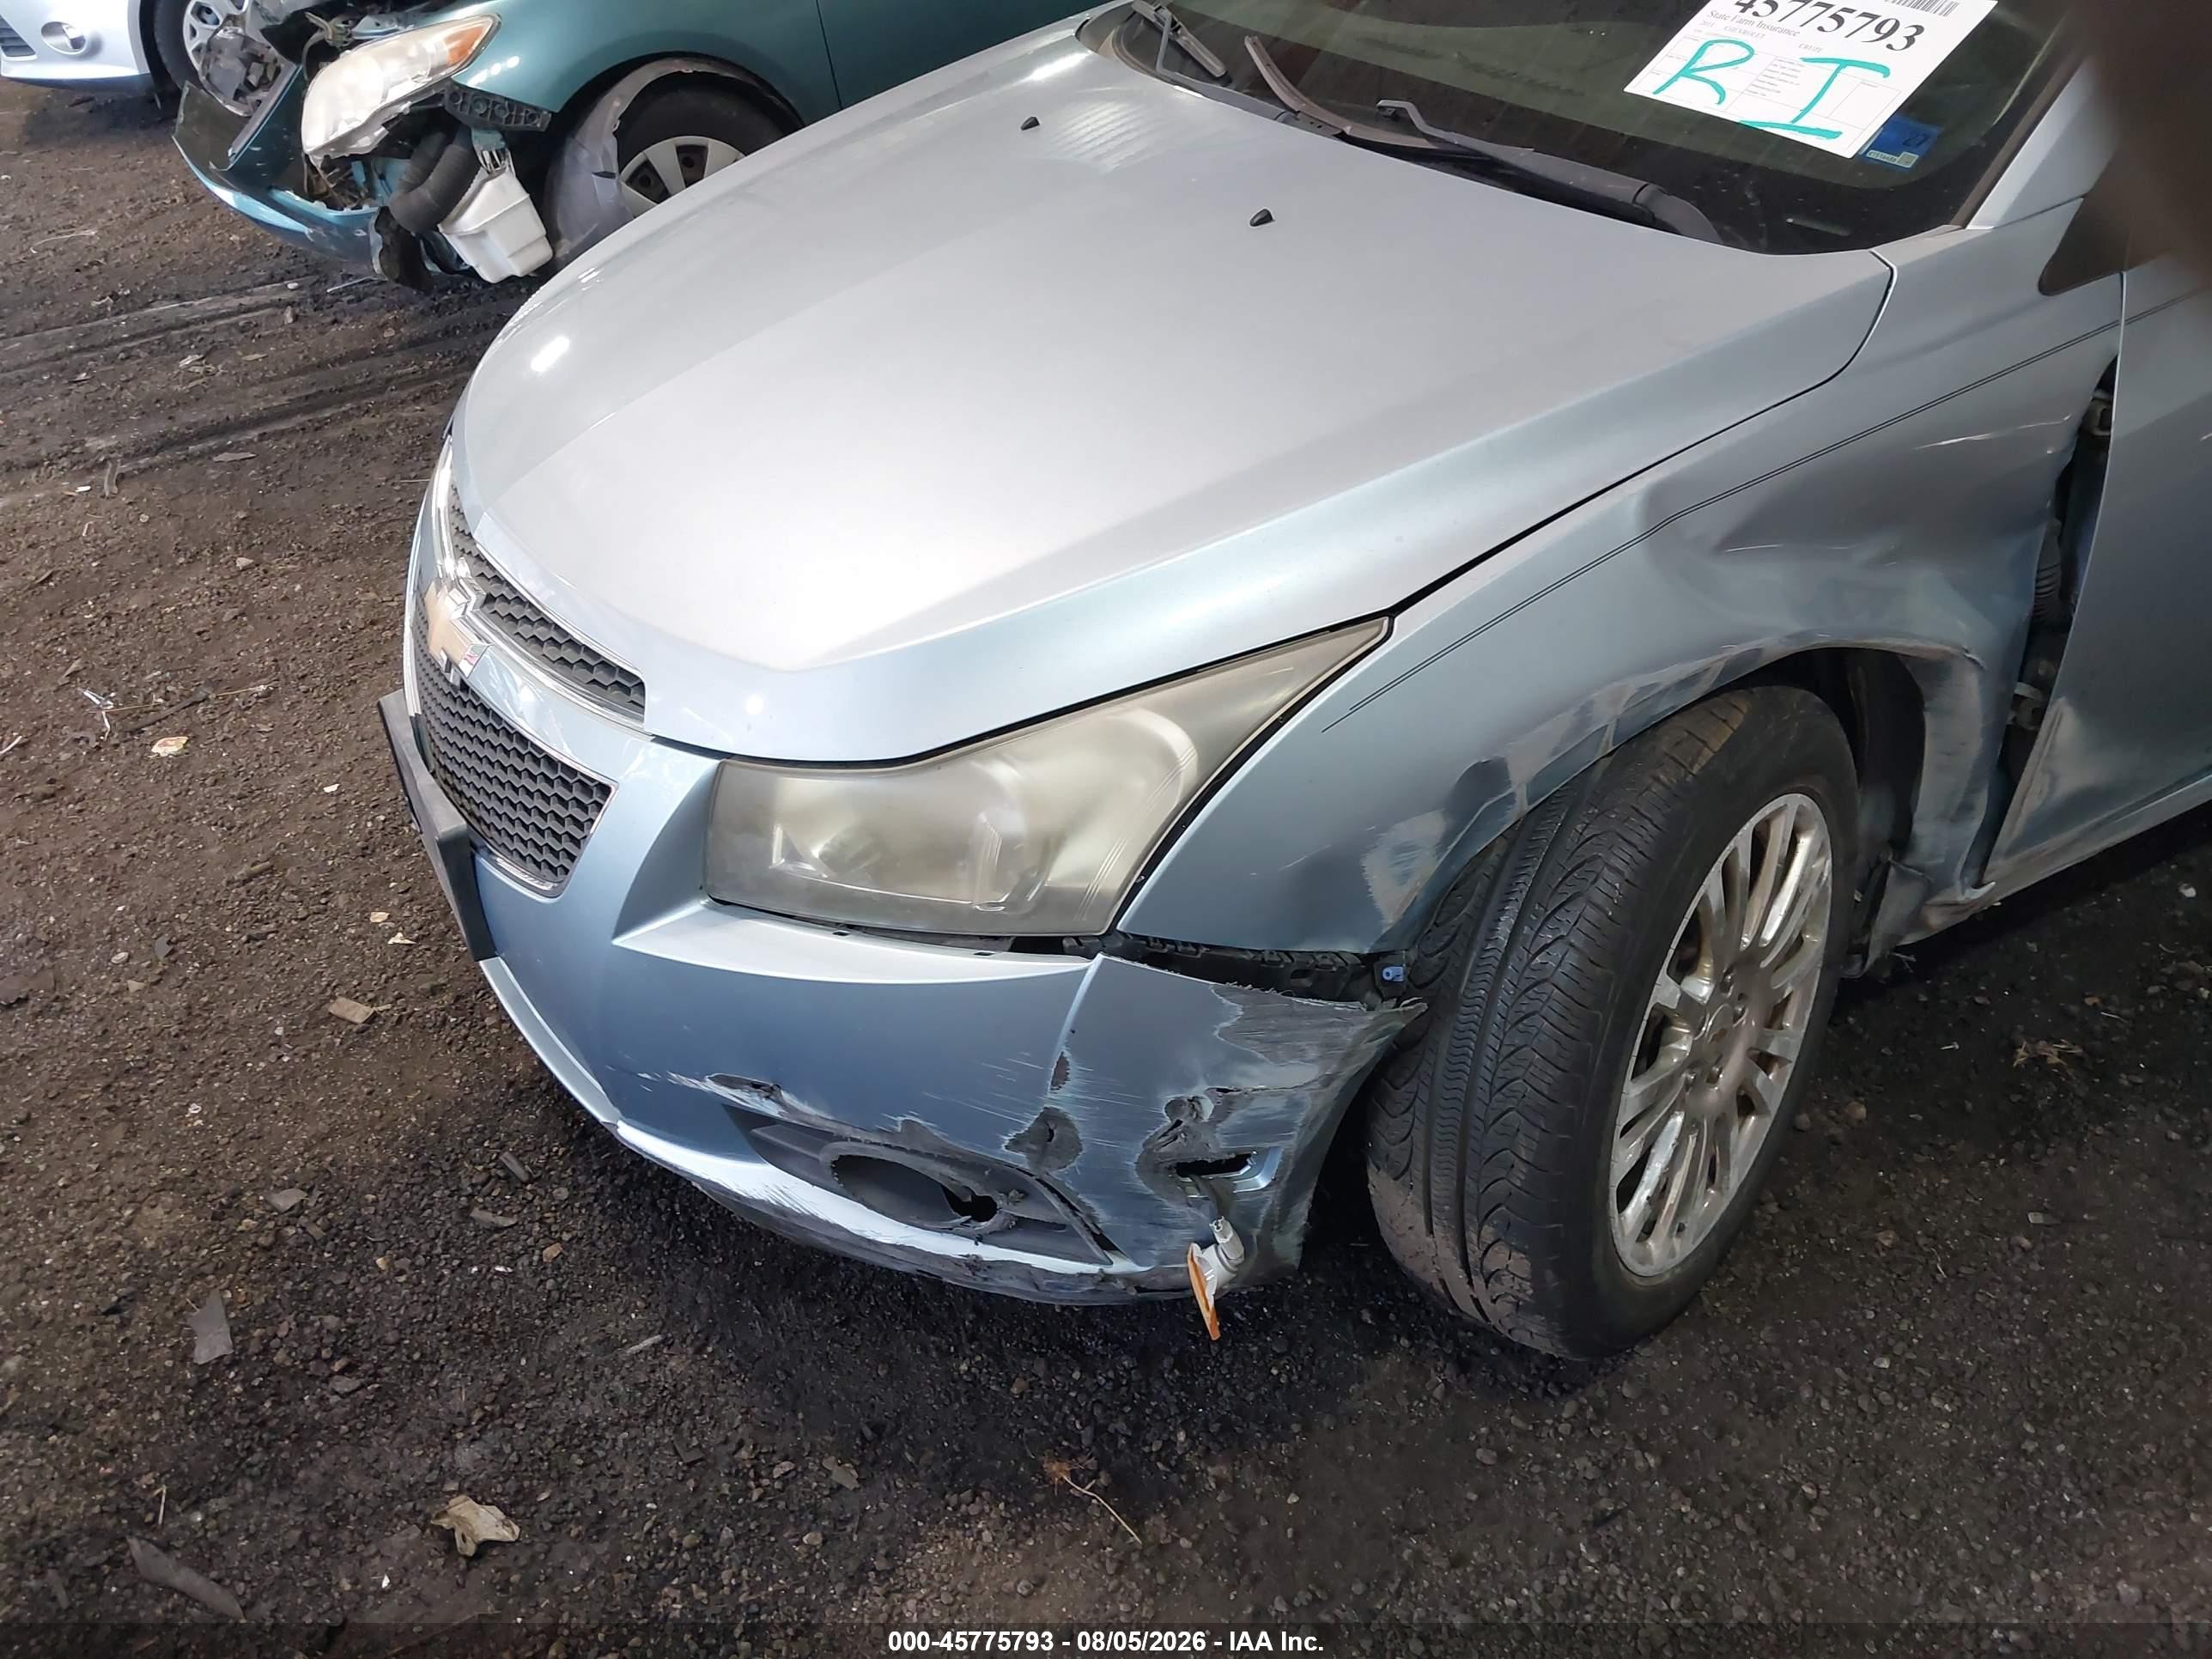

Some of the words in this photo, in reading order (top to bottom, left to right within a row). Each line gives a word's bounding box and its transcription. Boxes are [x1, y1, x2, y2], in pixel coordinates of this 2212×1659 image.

[1708, 10, 1731, 21] State
[1730, 15, 1755, 27] Farm
[1756, 20, 1801, 38] Insurance
[1652, 39, 1755, 105] R
